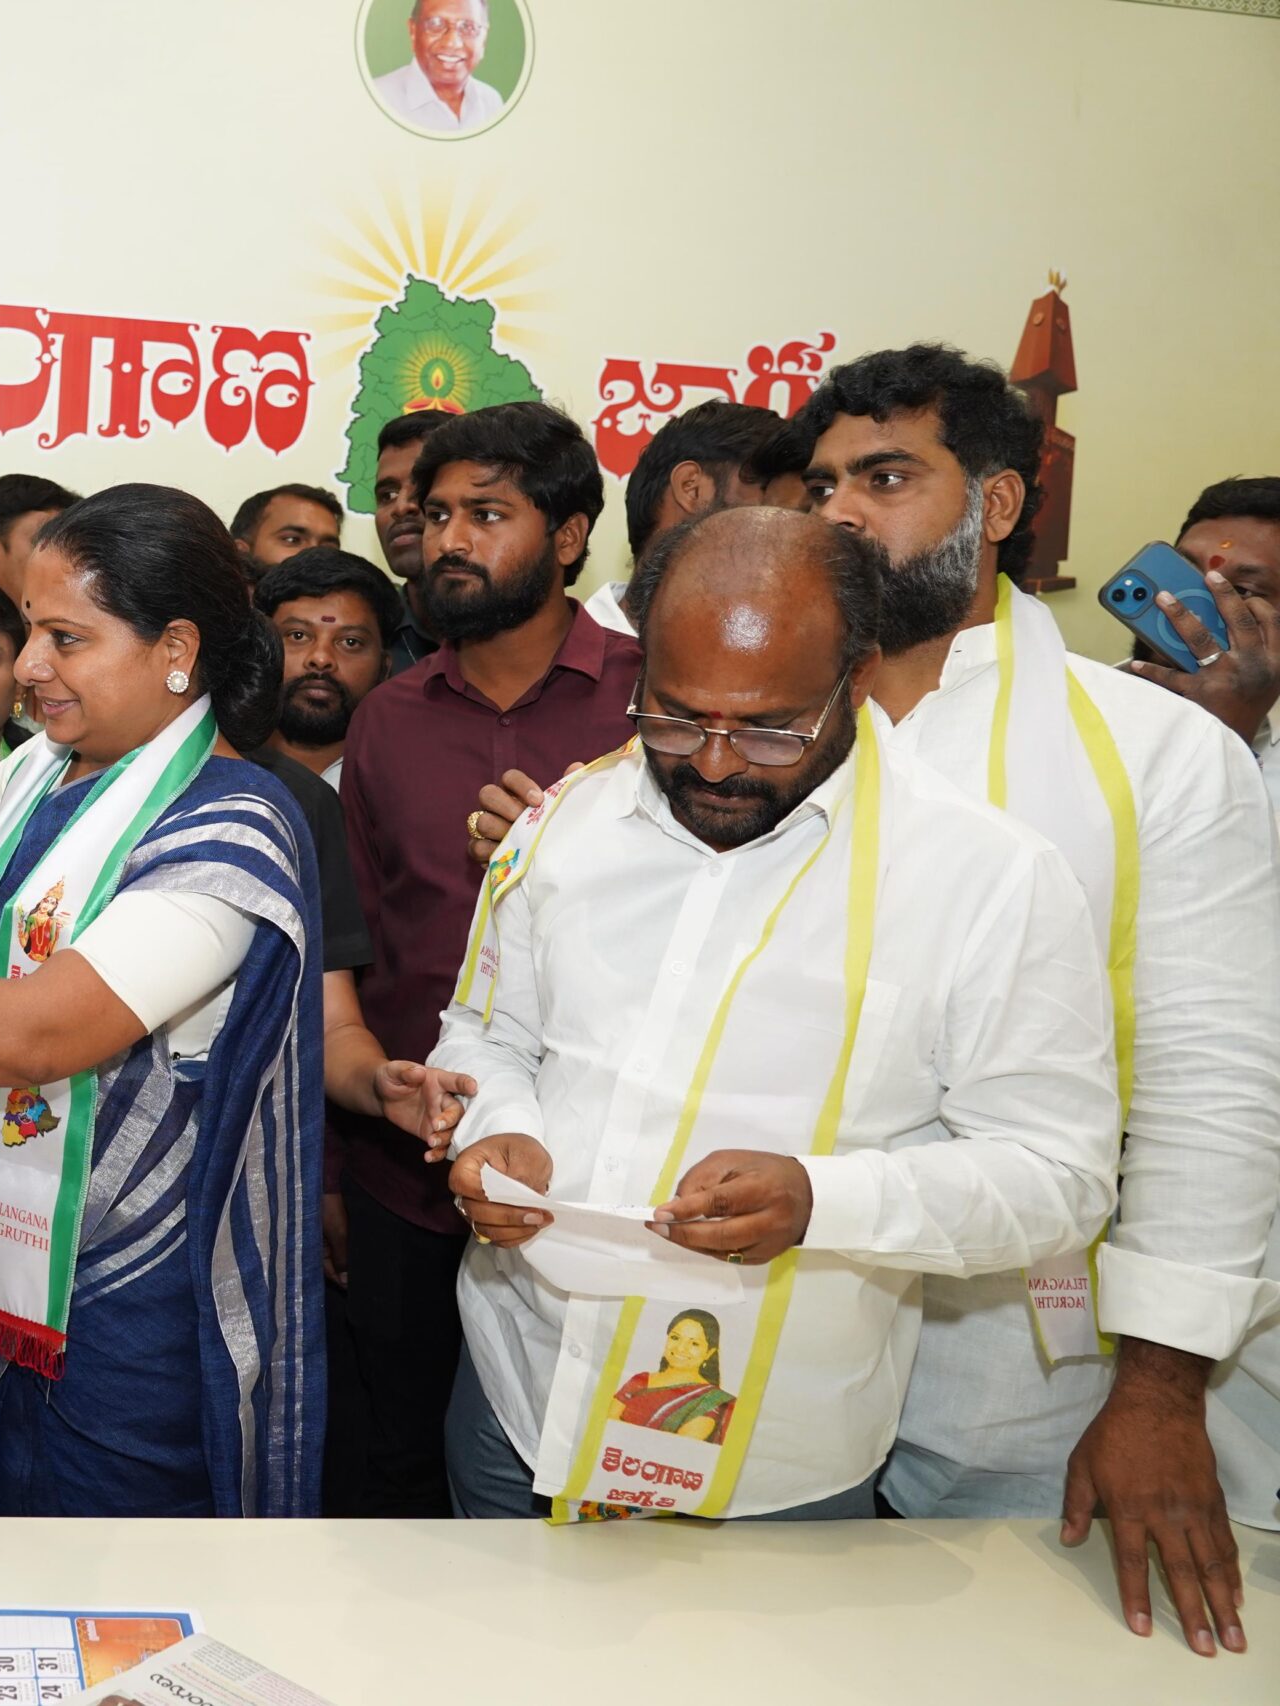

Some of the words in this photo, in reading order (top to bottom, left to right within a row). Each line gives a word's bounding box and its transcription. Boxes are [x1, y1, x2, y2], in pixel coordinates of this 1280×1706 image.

[602, 1446, 704, 1491] తెలంగాణ
[38, 1656, 59, 1670] 31
[42, 1685, 63, 1700] 24
